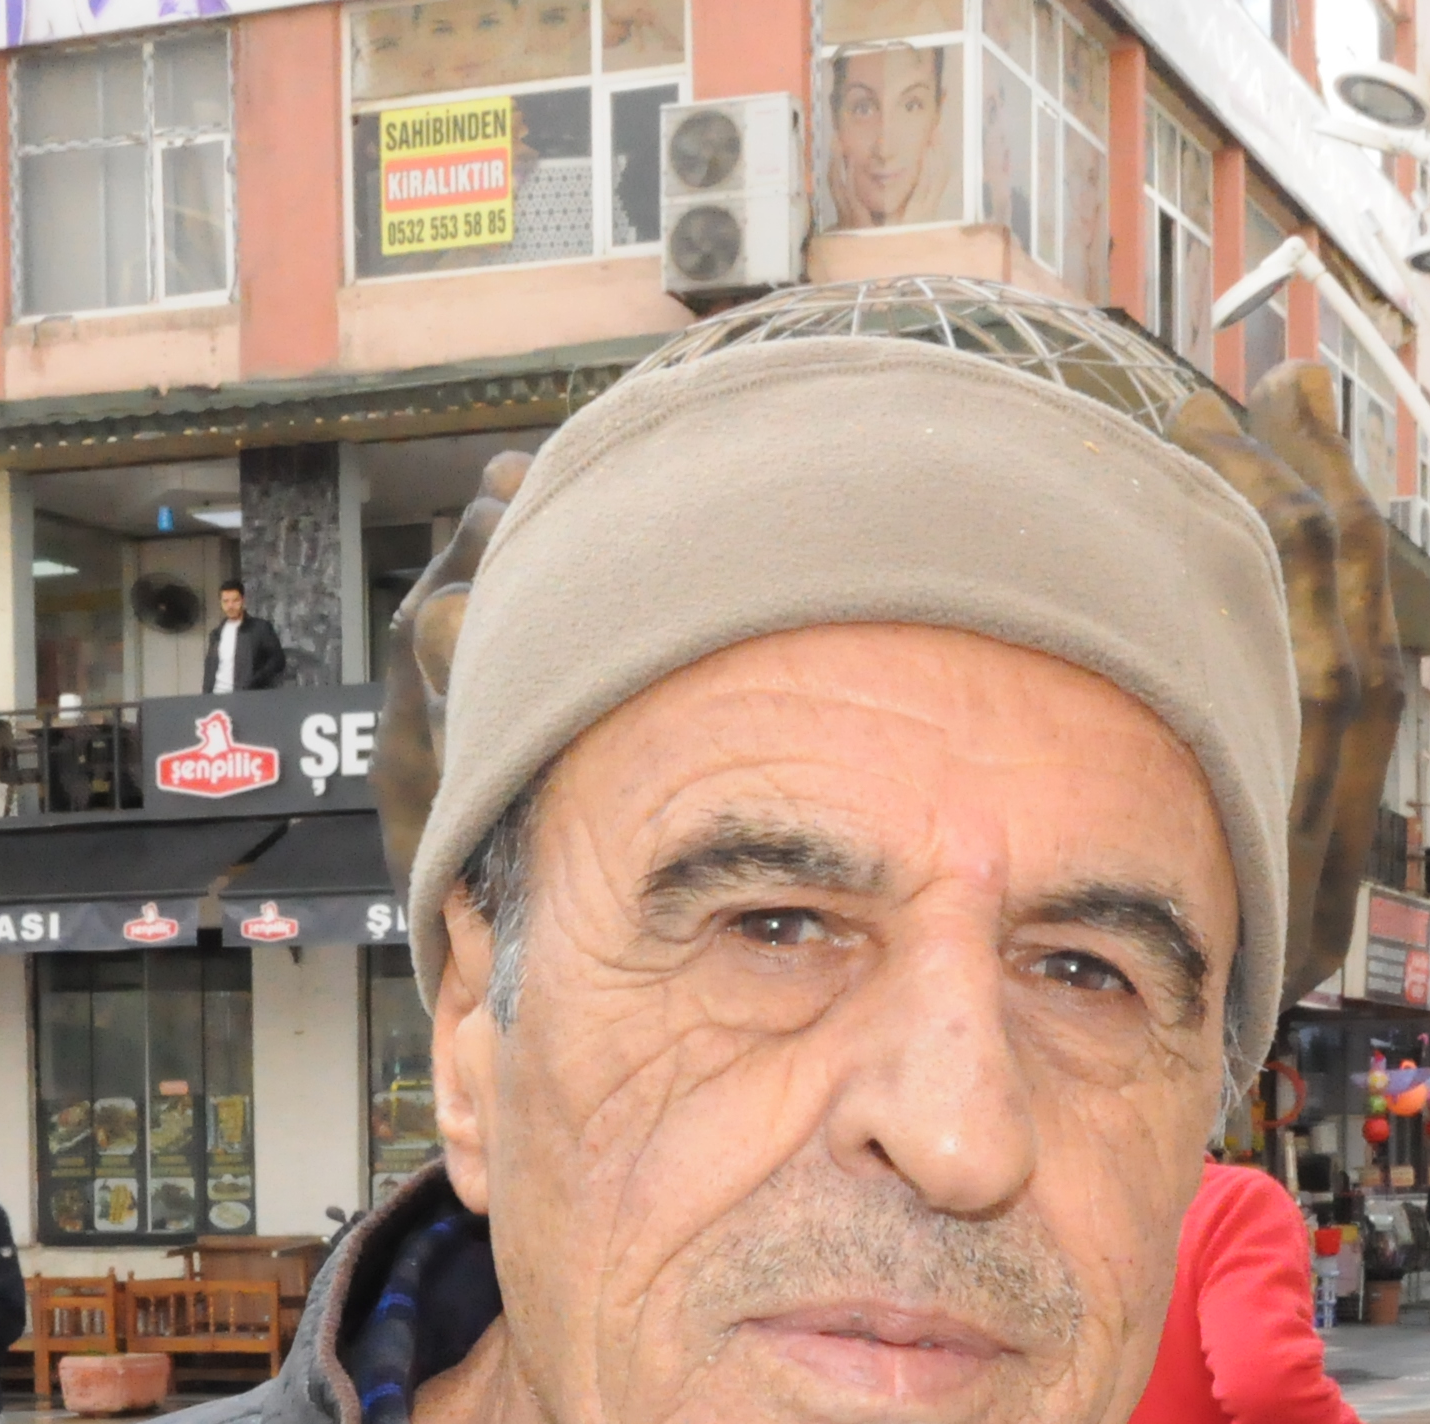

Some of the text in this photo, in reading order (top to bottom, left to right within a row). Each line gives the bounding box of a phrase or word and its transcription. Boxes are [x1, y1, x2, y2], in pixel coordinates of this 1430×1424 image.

[385, 109, 507, 151] SAHİBİNDEN
[387, 209, 507, 246] 0532 553 58 85
[171, 752, 263, 785] şenpiliç
